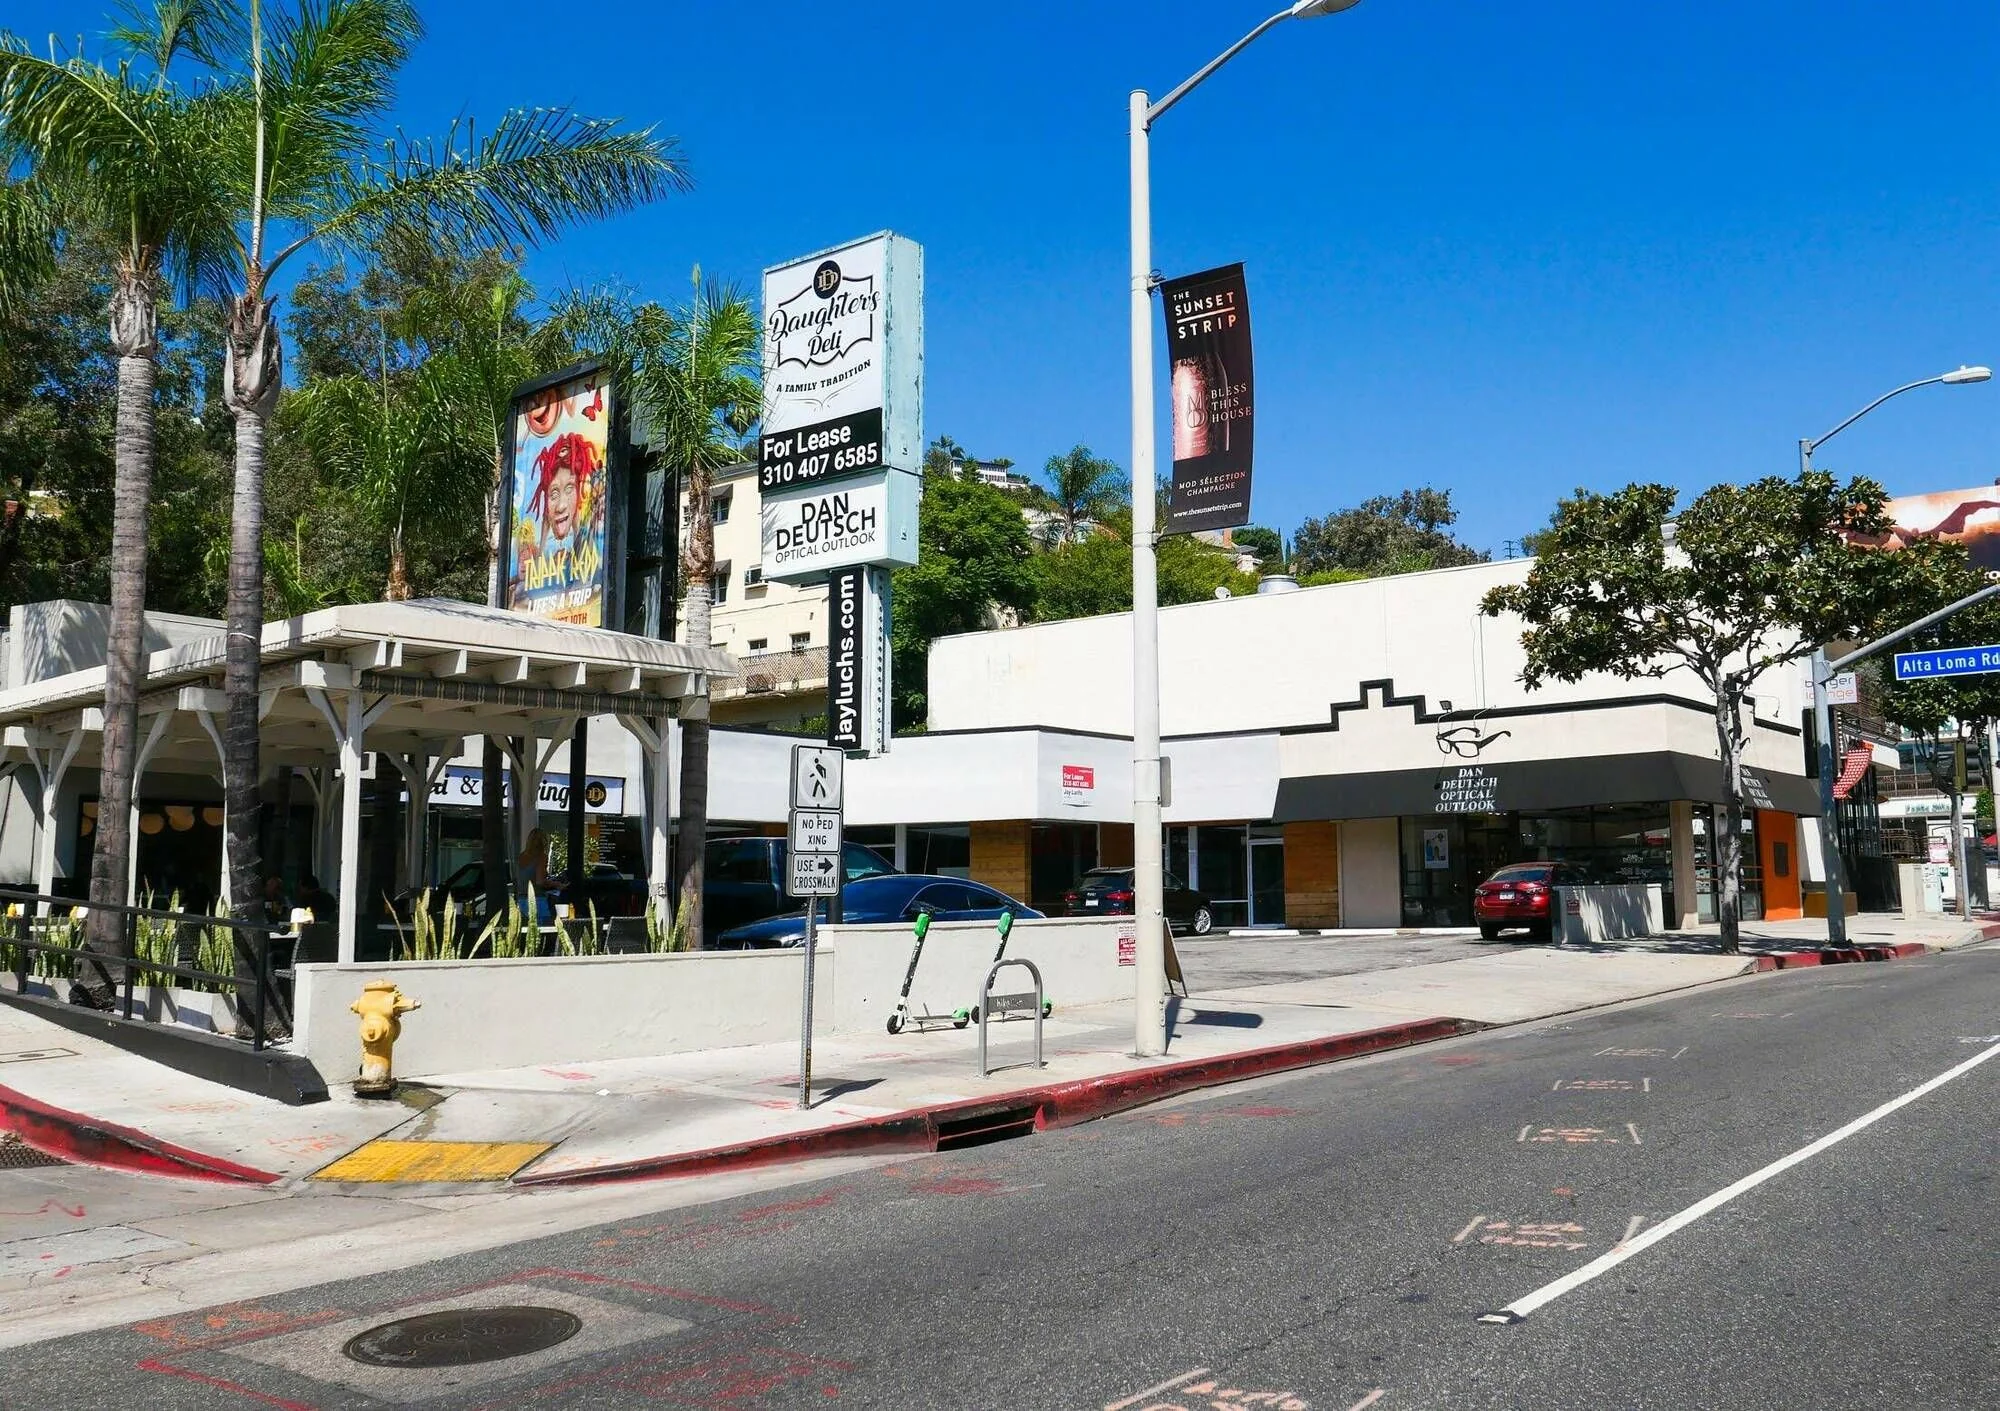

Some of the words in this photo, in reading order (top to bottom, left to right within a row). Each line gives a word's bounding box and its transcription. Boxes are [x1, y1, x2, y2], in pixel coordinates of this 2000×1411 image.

[1173, 291, 1190, 301] THE
[1175, 292, 1234, 316] SUNSET
[769, 291, 880, 342] Daughters
[1178, 315, 1236, 339] STRIP
[808, 330, 842, 356] Deli
[776, 384, 783, 392] A
[785, 382, 817, 392] FAMILY
[820, 359, 871, 388] TRADITION
[1211, 383, 1247, 399] BLESS
[1211, 397, 1239, 411] THIS
[1212, 406, 1251, 423] HOUSE
[764, 438, 793, 460] For
[797, 425, 851, 454] Lease
[763, 461, 793, 485] 310
[798, 453, 830, 478] 407
[834, 442, 877, 471] 6585
[1179, 480, 1197, 489] MOD
[1199, 472, 1246, 486] SÉLECTION
[1187, 482, 1236, 497] CHAMPAGNE
[802, 493, 849, 525] DAN
[1173, 502, 1242, 518] www.thesunsetstrip.com
[776, 507, 875, 551] DEUTSCH
[775, 545, 819, 563] OPTICAL
[822, 530, 875, 553] OUTLOOK
[560, 593, 566, 609] A
[568, 587, 592, 608] TRIP
[835, 574, 857, 743] jayluchs.com
[1903, 659, 1931, 673] Alta
[1937, 657, 1976, 670] Loma
[1982, 652, 2000, 666] Rd
[1805, 677, 1853, 689] bger
[1459, 767, 1483, 778] DAN
[460, 775, 479, 796] &
[1442, 777, 1497, 789] DEUTSCH
[1440, 789, 1493, 800] OPTICAL
[1435, 800, 1496, 812] OUTLOOK
[802, 819, 813, 830] NO
[816, 819, 833, 830] PED
[807, 834, 827, 845] XING
[797, 859, 814, 872] USE
[794, 876, 836, 889] CROSSWALK
